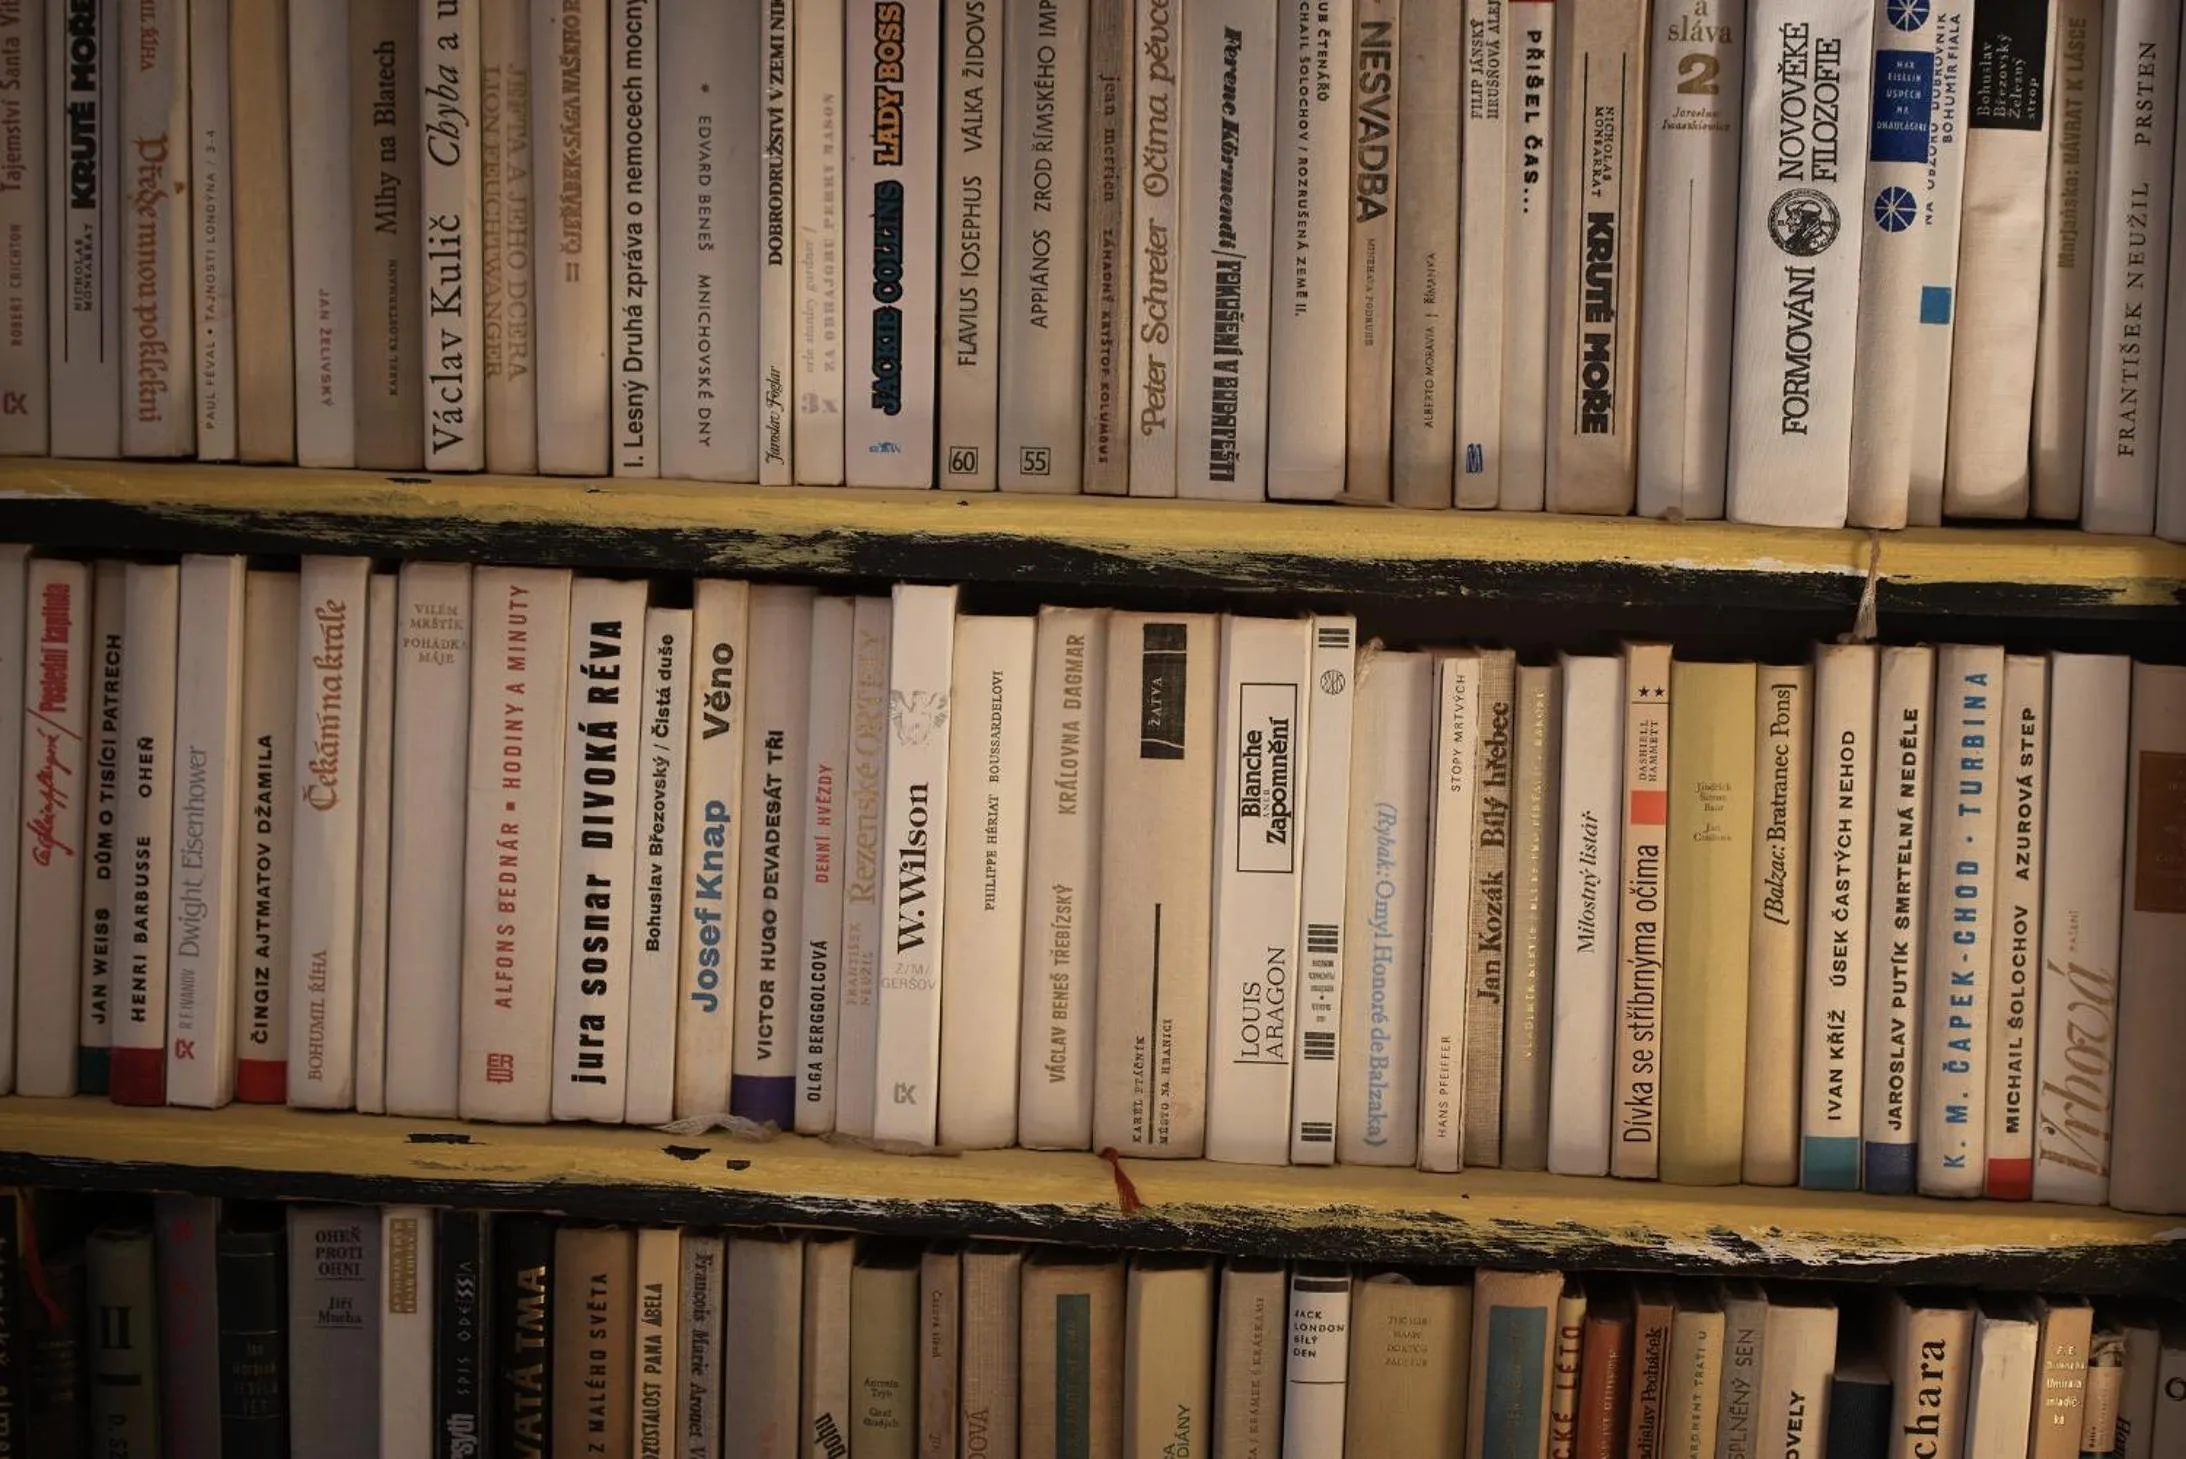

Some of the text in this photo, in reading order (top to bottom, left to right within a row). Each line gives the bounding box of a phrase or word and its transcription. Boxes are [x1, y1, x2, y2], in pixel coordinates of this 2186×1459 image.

[1316, 29, 1330, 102] ČTENÁŘŮ
[1355, 21, 1393, 223] NESVADBA
[1468, 19, 1485, 120] FILIP JÁNSKÝ
[1524, 30, 1544, 123] PŘIŠEL
[1667, 14, 1733, 44] sláva
[1676, 53, 1720, 95] 2
[1810, 38, 1841, 182] FILOZOFIE
[1942, 14, 1961, 144] BOHUMÍR FIALA
[1977, 43, 1992, 117] Bohuslav
[1, 100, 27, 347] ROBERT Tajemství
[66, 102, 97, 210] KRUTÉ
[372, 40, 402, 235] Mlhy na Blatech
[764, 34, 785, 266] DOBRODRUŽSTVÍ ZEMI
[869, 1, 904, 416] JACKIE COLLINS LADY BOSS
[957, 87, 984, 367] FLAVIUS IOSEPHUS VÁLKA
[1029, 46, 1056, 329] APPIÁNOS ZROD ŘÍMSKÉHO
[1294, 56, 1311, 299] ŠOLOCHOV ROZRUŠENÁ ZEMĚ
[1776, 22, 1815, 436] FORMOVÁNÍ NOVOVĚKÉ
[201, 172, 217, 430] PAUL FÉVAL TAJNOSTI LONDÝNA
[425, 33, 470, 454] Václav Kulič Chyba a
[621, 77, 650, 448] Lesný Druhá zpráva o nemocech
[697, 116, 715, 448] EDVARD BENEŠ MNICHOVSKÉ DNY
[1140, 93, 1170, 437] Peter Schreier Očima
[1581, 213, 1617, 434] KRUTÉ MOŘE
[2116, 41, 2158, 458] FRANTIŠEK NEUŽIL PRSTEN
[951, 451, 976, 472] 60
[1024, 451, 1046, 472] 55
[1423, 379, 1435, 429] ALBERTO
[91, 634, 122, 1025] JAN WEISS DŮM O TISÍCI PATRECH
[494, 584, 530, 1009] ALFONS BEDNÁR HODINY A MINUTY
[645, 633, 675, 952] Bohuslav Březovský Čistá duše
[691, 643, 734, 1013] Josef Knap Věno
[984, 669, 1004, 911] PHILIPPE HÉRIAT BOUSSARDELOVI
[1241, 729, 1262, 818] Blanche
[1266, 717, 1291, 844] Zapomnění
[1450, 674, 1466, 793] STOPY MRTVÝCH
[1766, 743, 1790, 842] Bratranec
[1958, 673, 1988, 817] TURBINA
[130, 736, 155, 1023] HENRI BARBUSSE OHEŇ
[178, 745, 208, 958] Dwight Eisenhower
[250, 735, 273, 1045] ČINGIZ AJTMATOV DŽAMILA
[570, 620, 623, 1086] jura sosnar DIVOKÁ RÉVA
[757, 730, 785, 1061] VICTOR HUGO DEVADESÁT TŘI
[1044, 633, 1085, 1084] VÁCLAV BENEŠ TŘEBÍZSKÝ KRÁLOVNA DAGMAR
[1475, 701, 1510, 1004] Jan Kozák Bílý hřebec
[1576, 811, 1601, 954] Milostný listář
[1826, 730, 1856, 1121] IVAN KŘÍŽ ÚSEK ČASTÝCH NEHOD
[1886, 707, 1919, 1131] JAROSLAV PUTÍK SMRTELNÁ NEDĚLE
[2003, 706, 2036, 1134] MICHAIL ŠOLOCHOV AZUROVÁ STEP
[307, 949, 328, 1082] BOHUMIL ŘÍHA
[806, 940, 829, 1103] OLGA BERGGOLCOVÁ
[1240, 981, 1262, 1058] LOUIS
[1266, 946, 1287, 1060] ARAGON
[1622, 844, 1663, 1143] Dívka se stříbrnýma očima
[315, 1245, 363, 1260] PROTI
[515, 1266, 546, 1353] TMA
[640, 1283, 664, 1374] PANA ÁBELA
[1294, 1309, 1323, 1320] JACK
[1294, 1322, 1345, 1333] LONDON
[1735, 1328, 1755, 1367] SEN
[584, 1274, 608, 1433] MALÉHO SVĚTA
[1293, 1346, 1317, 1358] DEN
[1555, 1326, 1581, 1391] LÉTO
